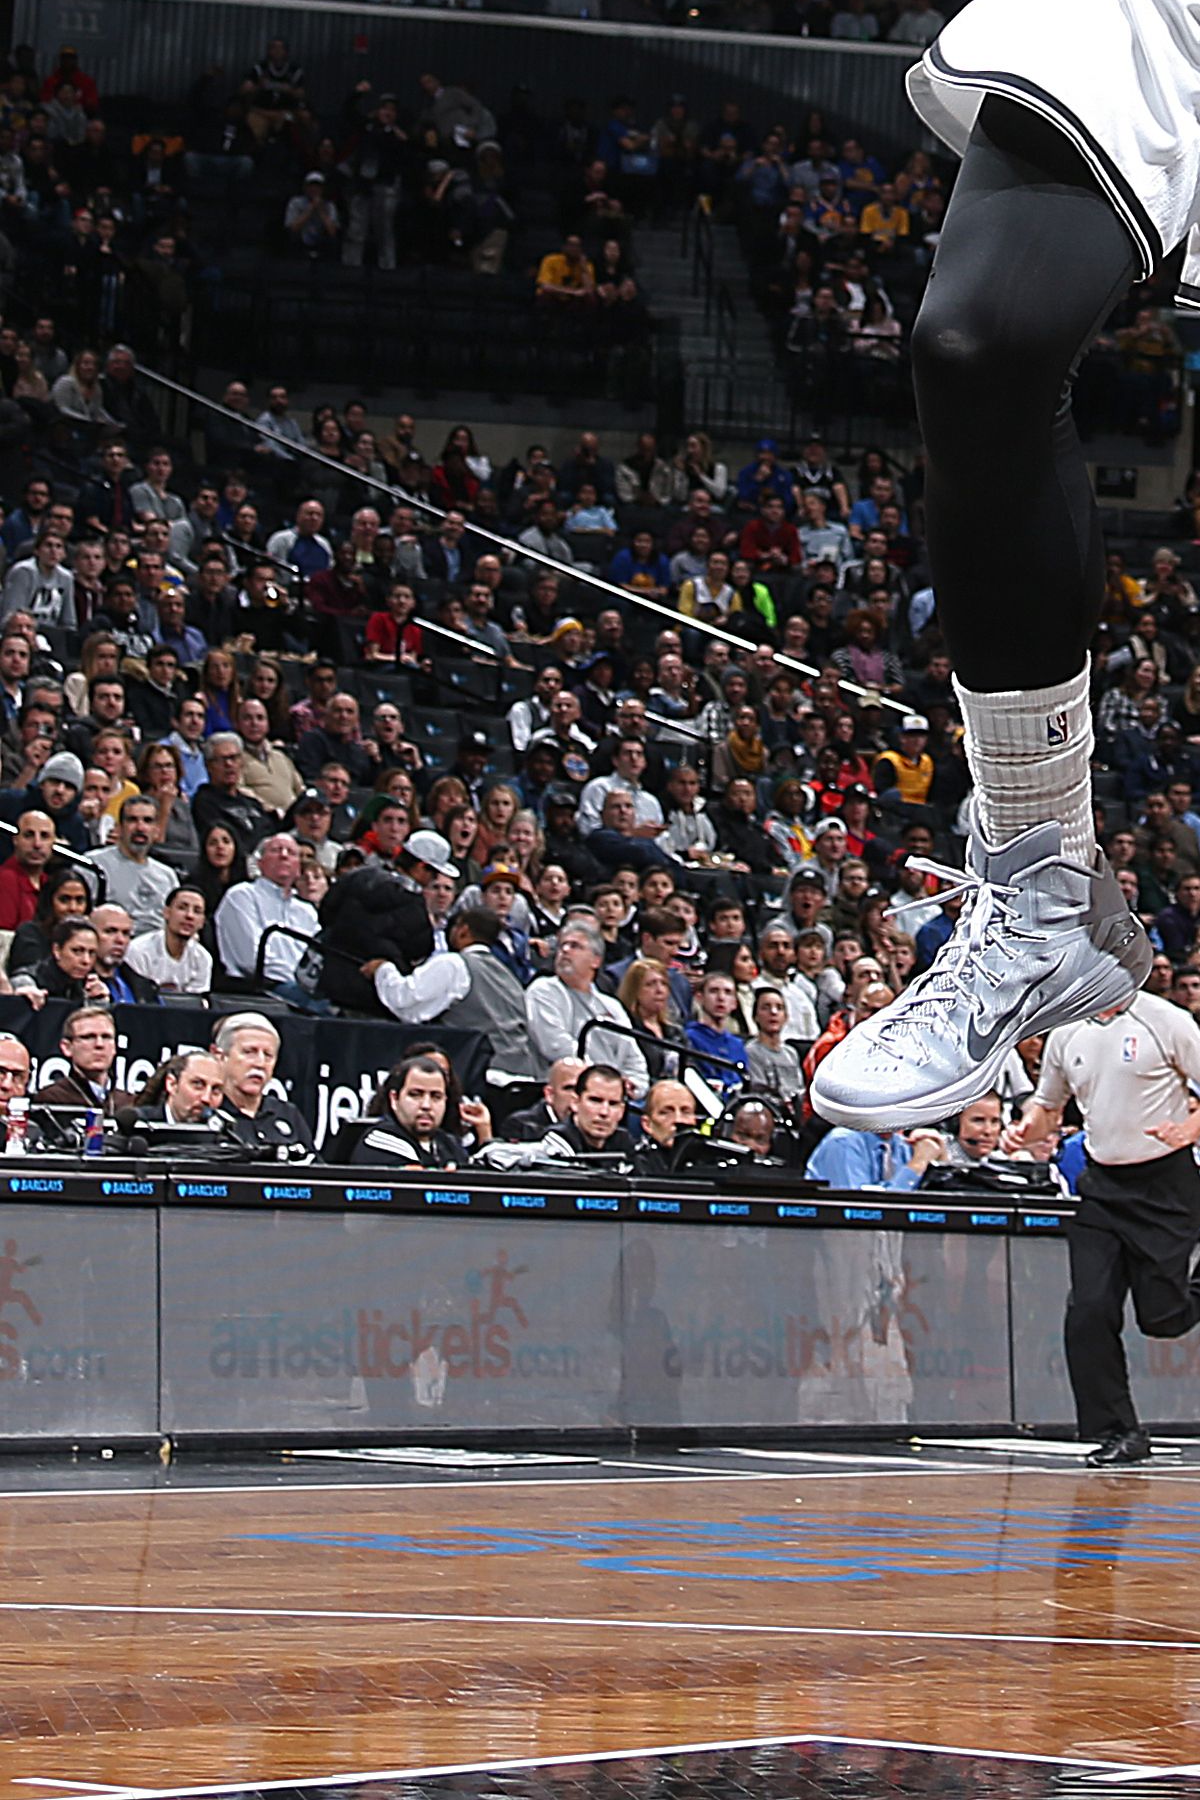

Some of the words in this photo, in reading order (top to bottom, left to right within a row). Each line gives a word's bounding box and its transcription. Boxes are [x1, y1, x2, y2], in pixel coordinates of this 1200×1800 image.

[21, 1179, 63, 1191] BARCLAYS
[112, 1182, 153, 1194] BARCLAYS
[187, 1184, 227, 1196] BARCLAYS
[273, 1187, 311, 1198] BARCLAYS
